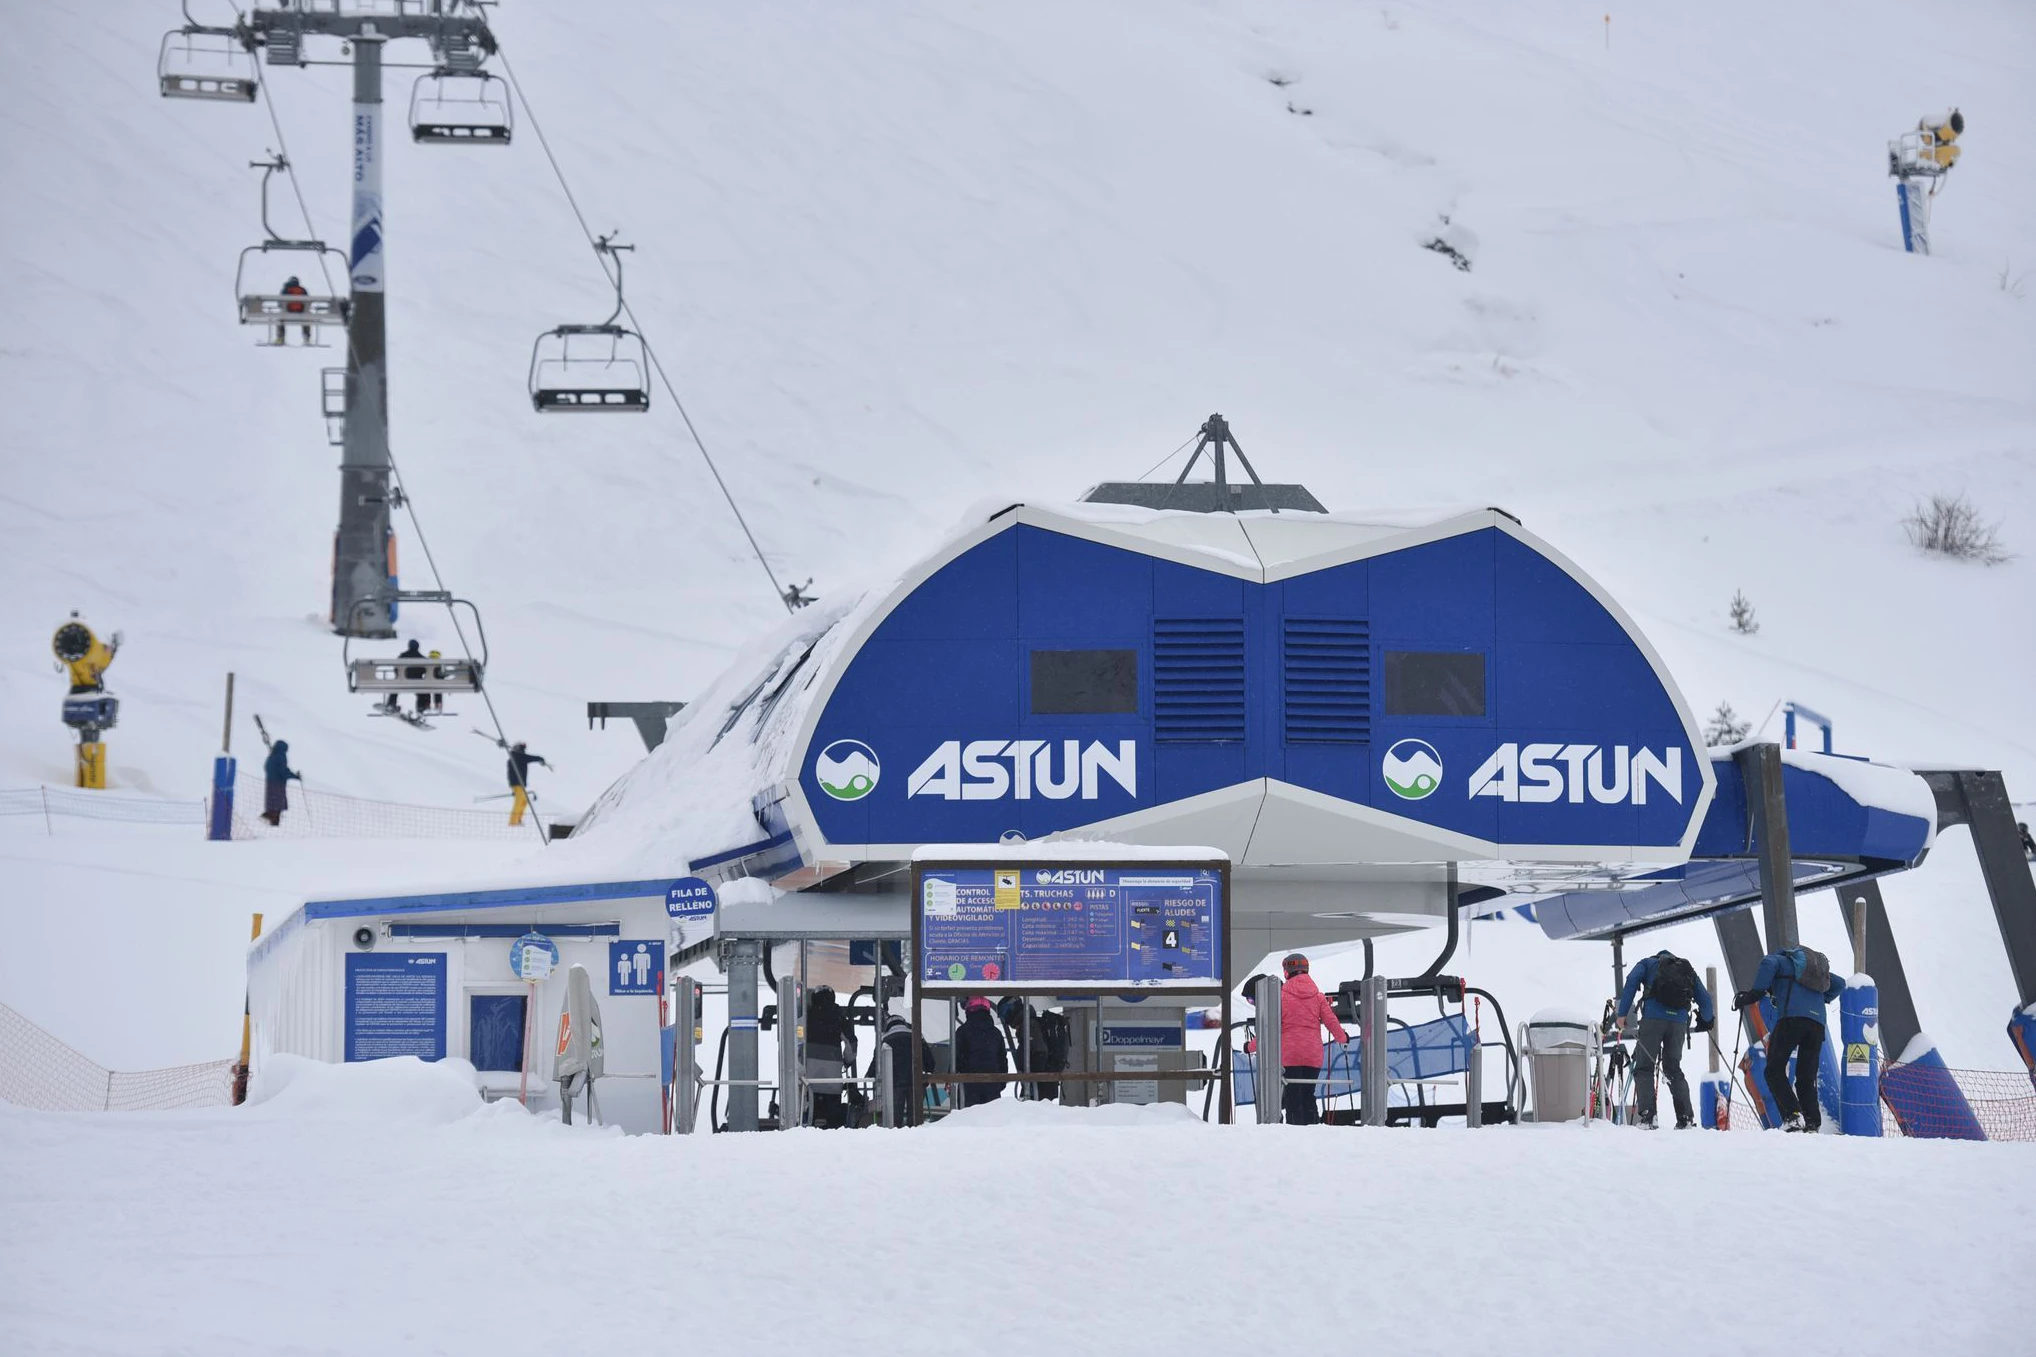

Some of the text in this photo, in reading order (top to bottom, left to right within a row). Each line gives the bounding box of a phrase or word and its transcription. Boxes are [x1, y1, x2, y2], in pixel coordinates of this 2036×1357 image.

[908, 740, 1136, 800] ASTUN
[1469, 743, 1682, 805] ASTUN
[1051, 870, 1105, 884] ASTUN
[671, 887, 708, 898] FILA DE
[1034, 890, 1074, 898] TRUCHAS
[669, 901, 712, 912] RELLENO
[1164, 899, 1206, 907] RIESGO DE
[1165, 932, 1177, 947] 4
[1112, 1035, 1164, 1044] Doppelmayr
